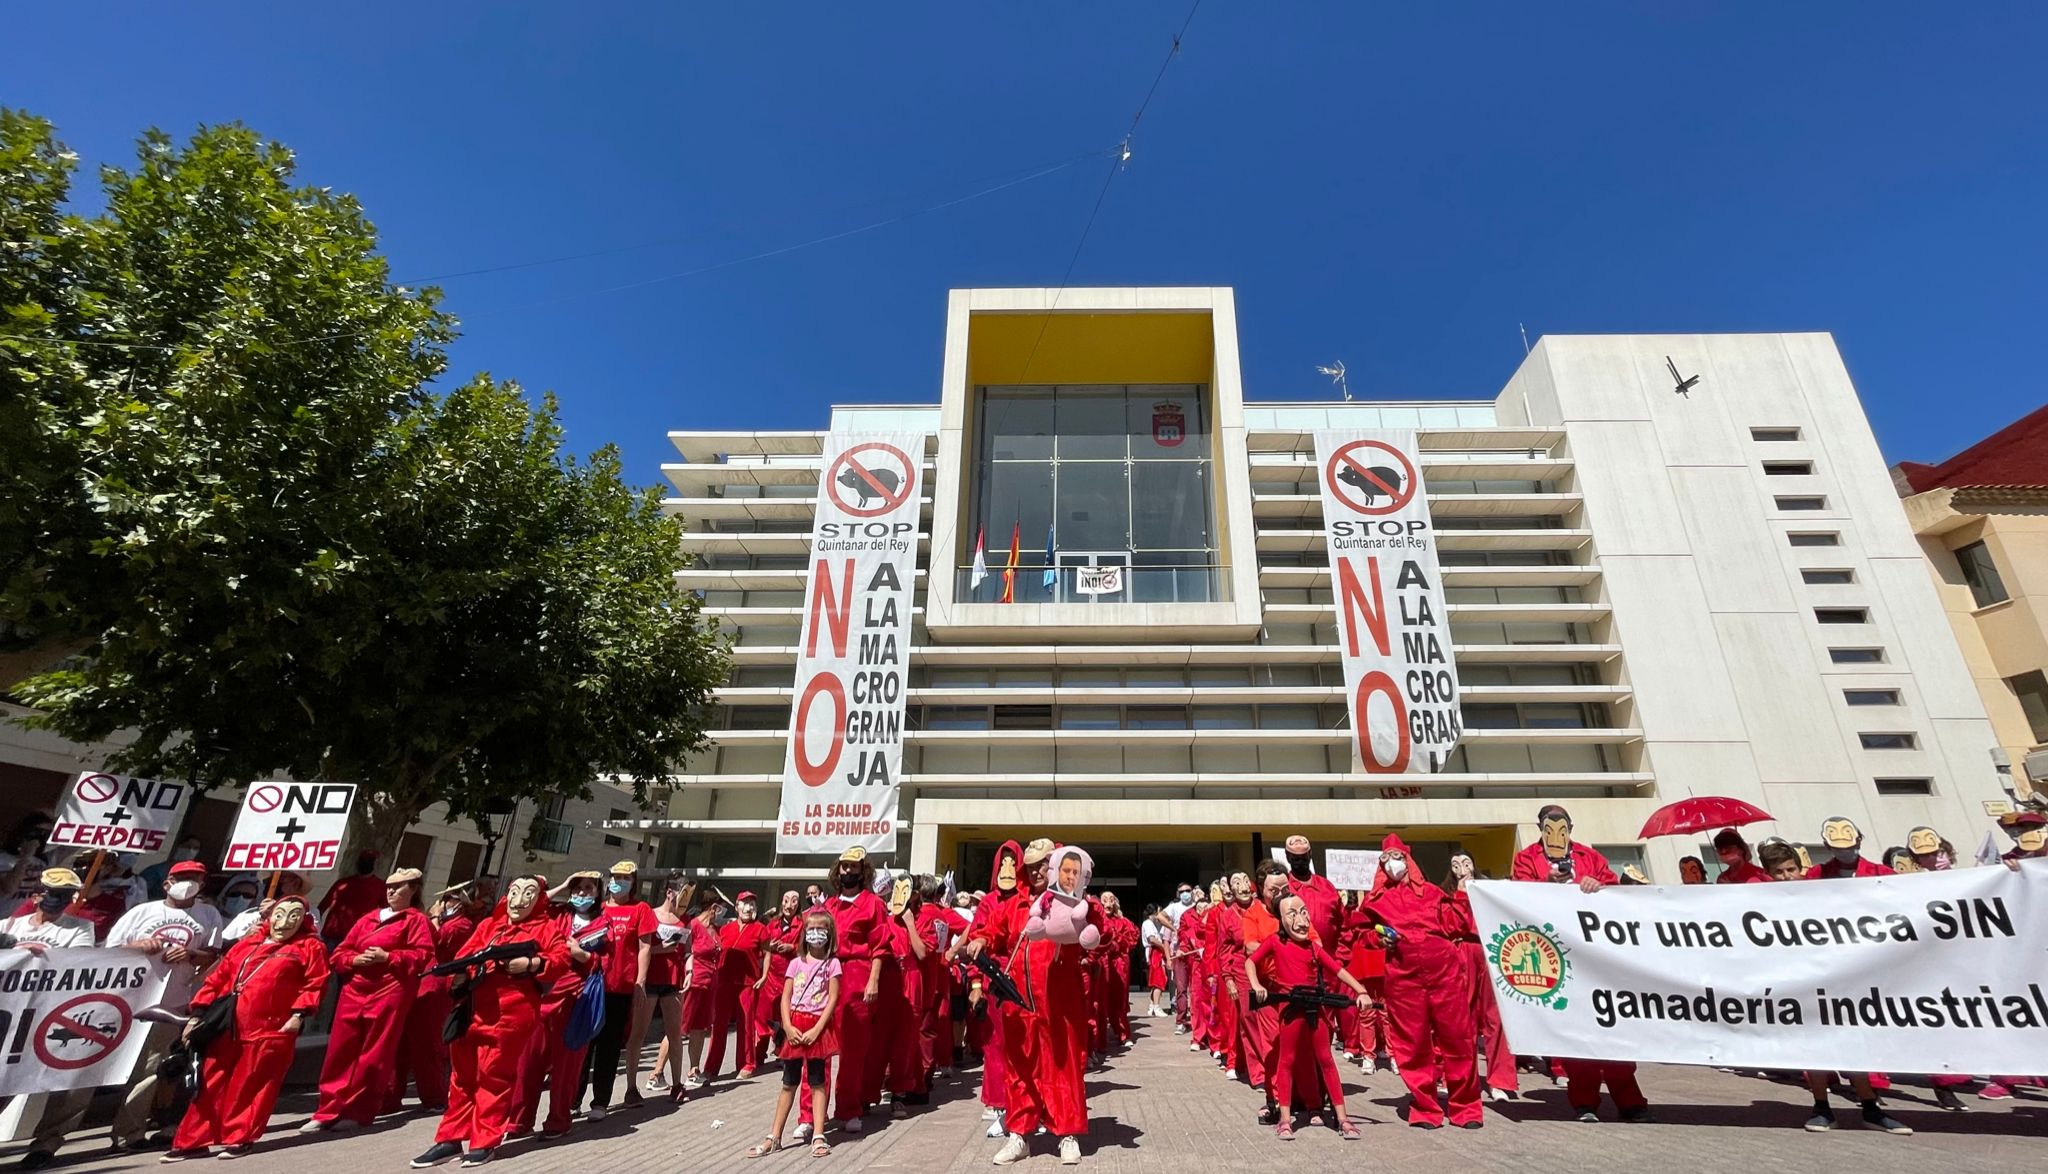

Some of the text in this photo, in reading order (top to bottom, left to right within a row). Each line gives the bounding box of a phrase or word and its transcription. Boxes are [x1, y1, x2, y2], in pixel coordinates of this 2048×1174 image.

[819, 522, 913, 538] STOP
[1332, 521, 1427, 537] STOP
[817, 539, 910, 554] Quintanar del Rey
[1334, 537, 1427, 551] Quintanar del Rey
[867, 562, 902, 592] A
[1396, 560, 1430, 590] A
[865, 598, 899, 628] LA
[1399, 595, 1437, 627] LA
[120, 779, 184, 811] NO
[282, 785, 355, 814] NO
[805, 804, 872, 818] LA SALUD
[51, 823, 168, 851] CERDOS
[782, 820, 890, 836] ES LO PRIMERO
[225, 840, 340, 868] CERDOS
[1577, 897, 2016, 947] Por una Cuenca SIN
[1501, 932, 1559, 966] PUEBLOS VIVOS
[1513, 974, 1548, 986] CUENCA
[1591, 984, 2048, 1028] ganadería industrial
